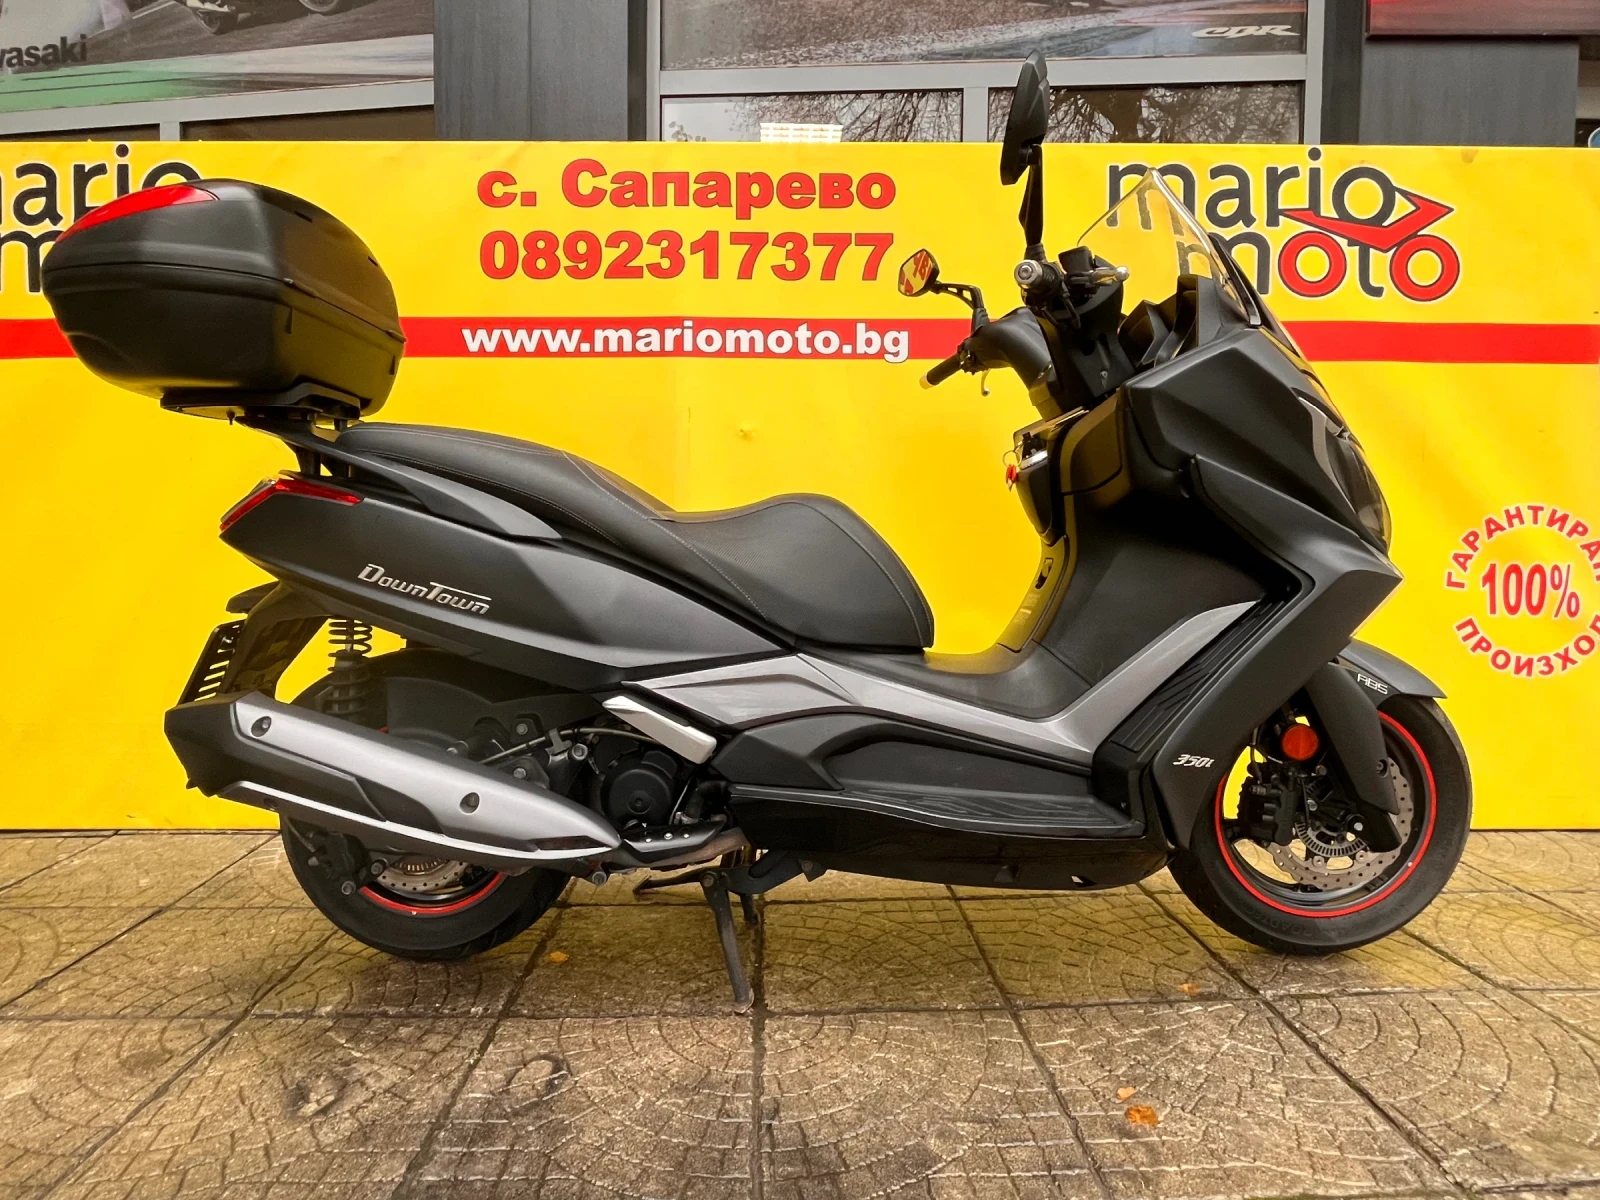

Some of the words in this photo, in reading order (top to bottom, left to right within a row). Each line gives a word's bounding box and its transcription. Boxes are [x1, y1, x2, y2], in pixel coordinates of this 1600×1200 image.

[477, 170, 537, 207] с.
[562, 158, 897, 220] Сапарево
[1106, 147, 1396, 229] mario
[480, 230, 894, 281] 0892317377
[461, 320, 910, 364] www.mariomoto.bg
[1482, 563, 1580, 618] 100%
[1357, 673, 1388, 695] ABS
